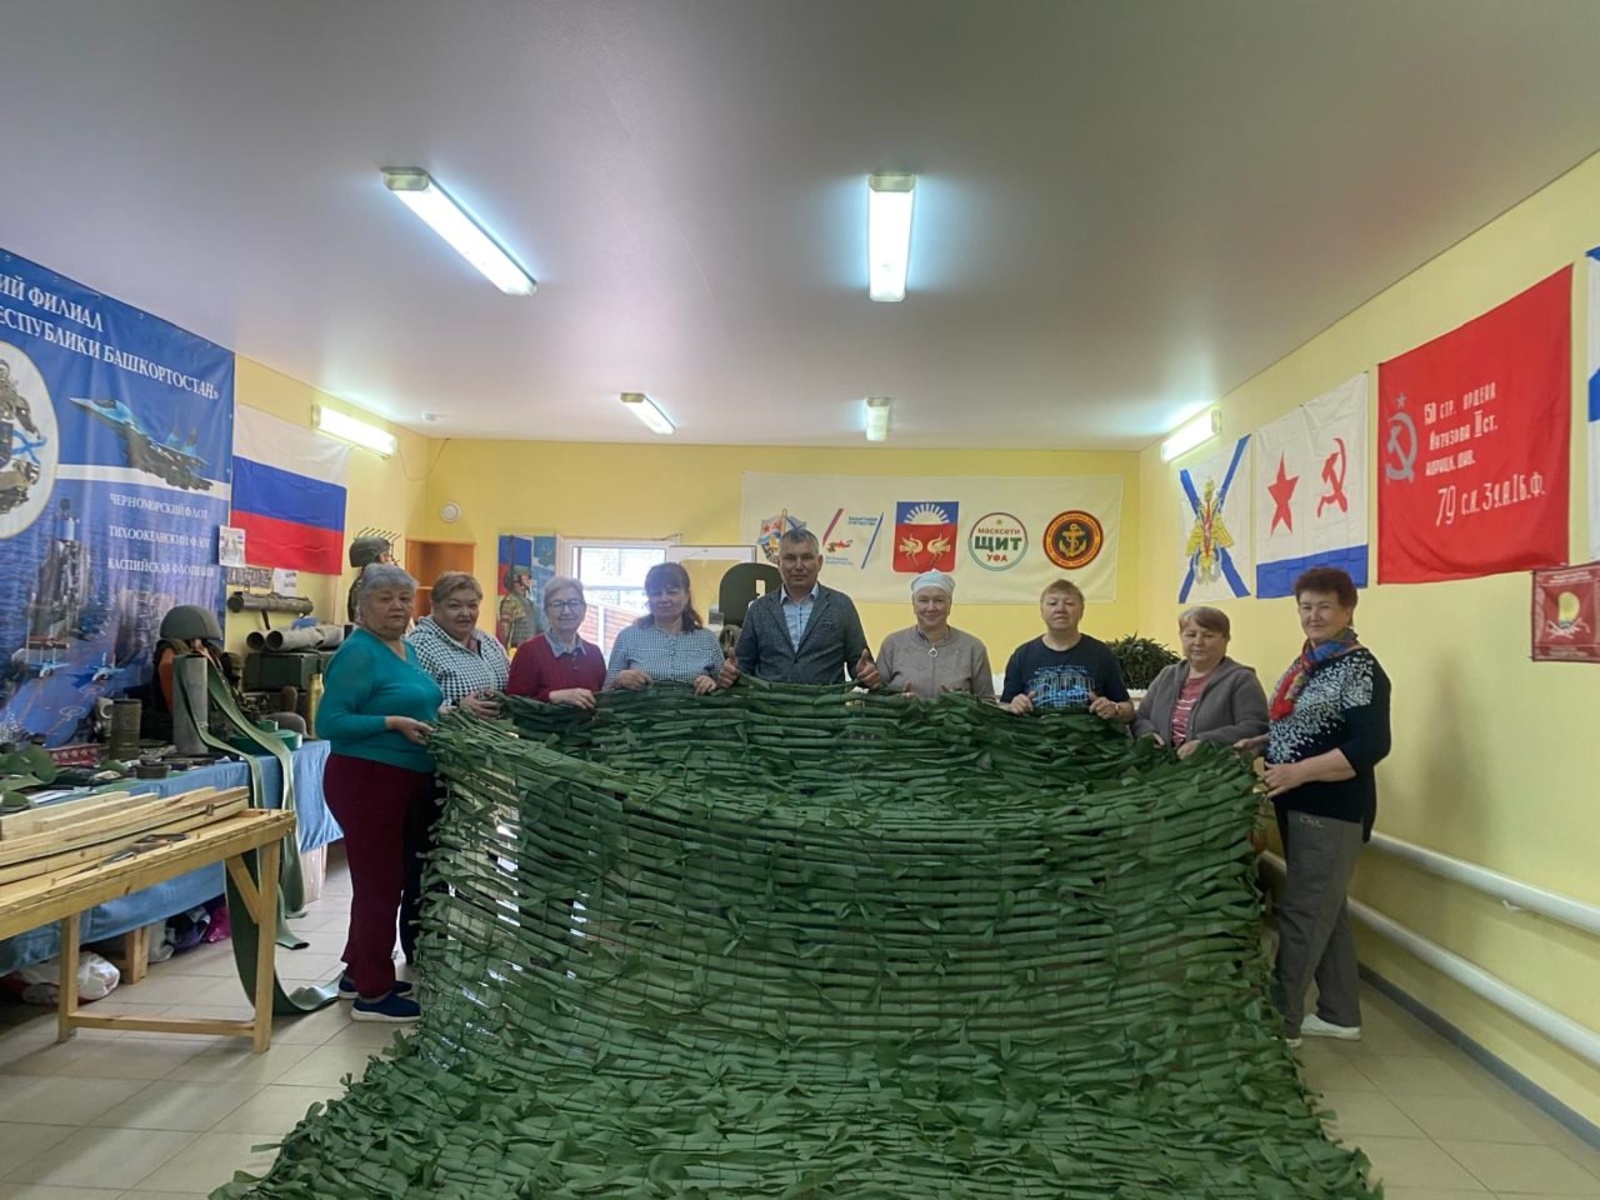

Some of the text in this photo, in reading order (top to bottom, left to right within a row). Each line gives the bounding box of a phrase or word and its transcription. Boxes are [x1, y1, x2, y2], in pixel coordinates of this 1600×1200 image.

[28, 286, 103, 332] ФИЛИАЛ
[103, 344, 219, 399] БАШКОРТОСТАН»
[1436, 485, 1456, 527] 79
[974, 535, 1022, 552] ЩИТ
[986, 553, 1008, 562] УФА
